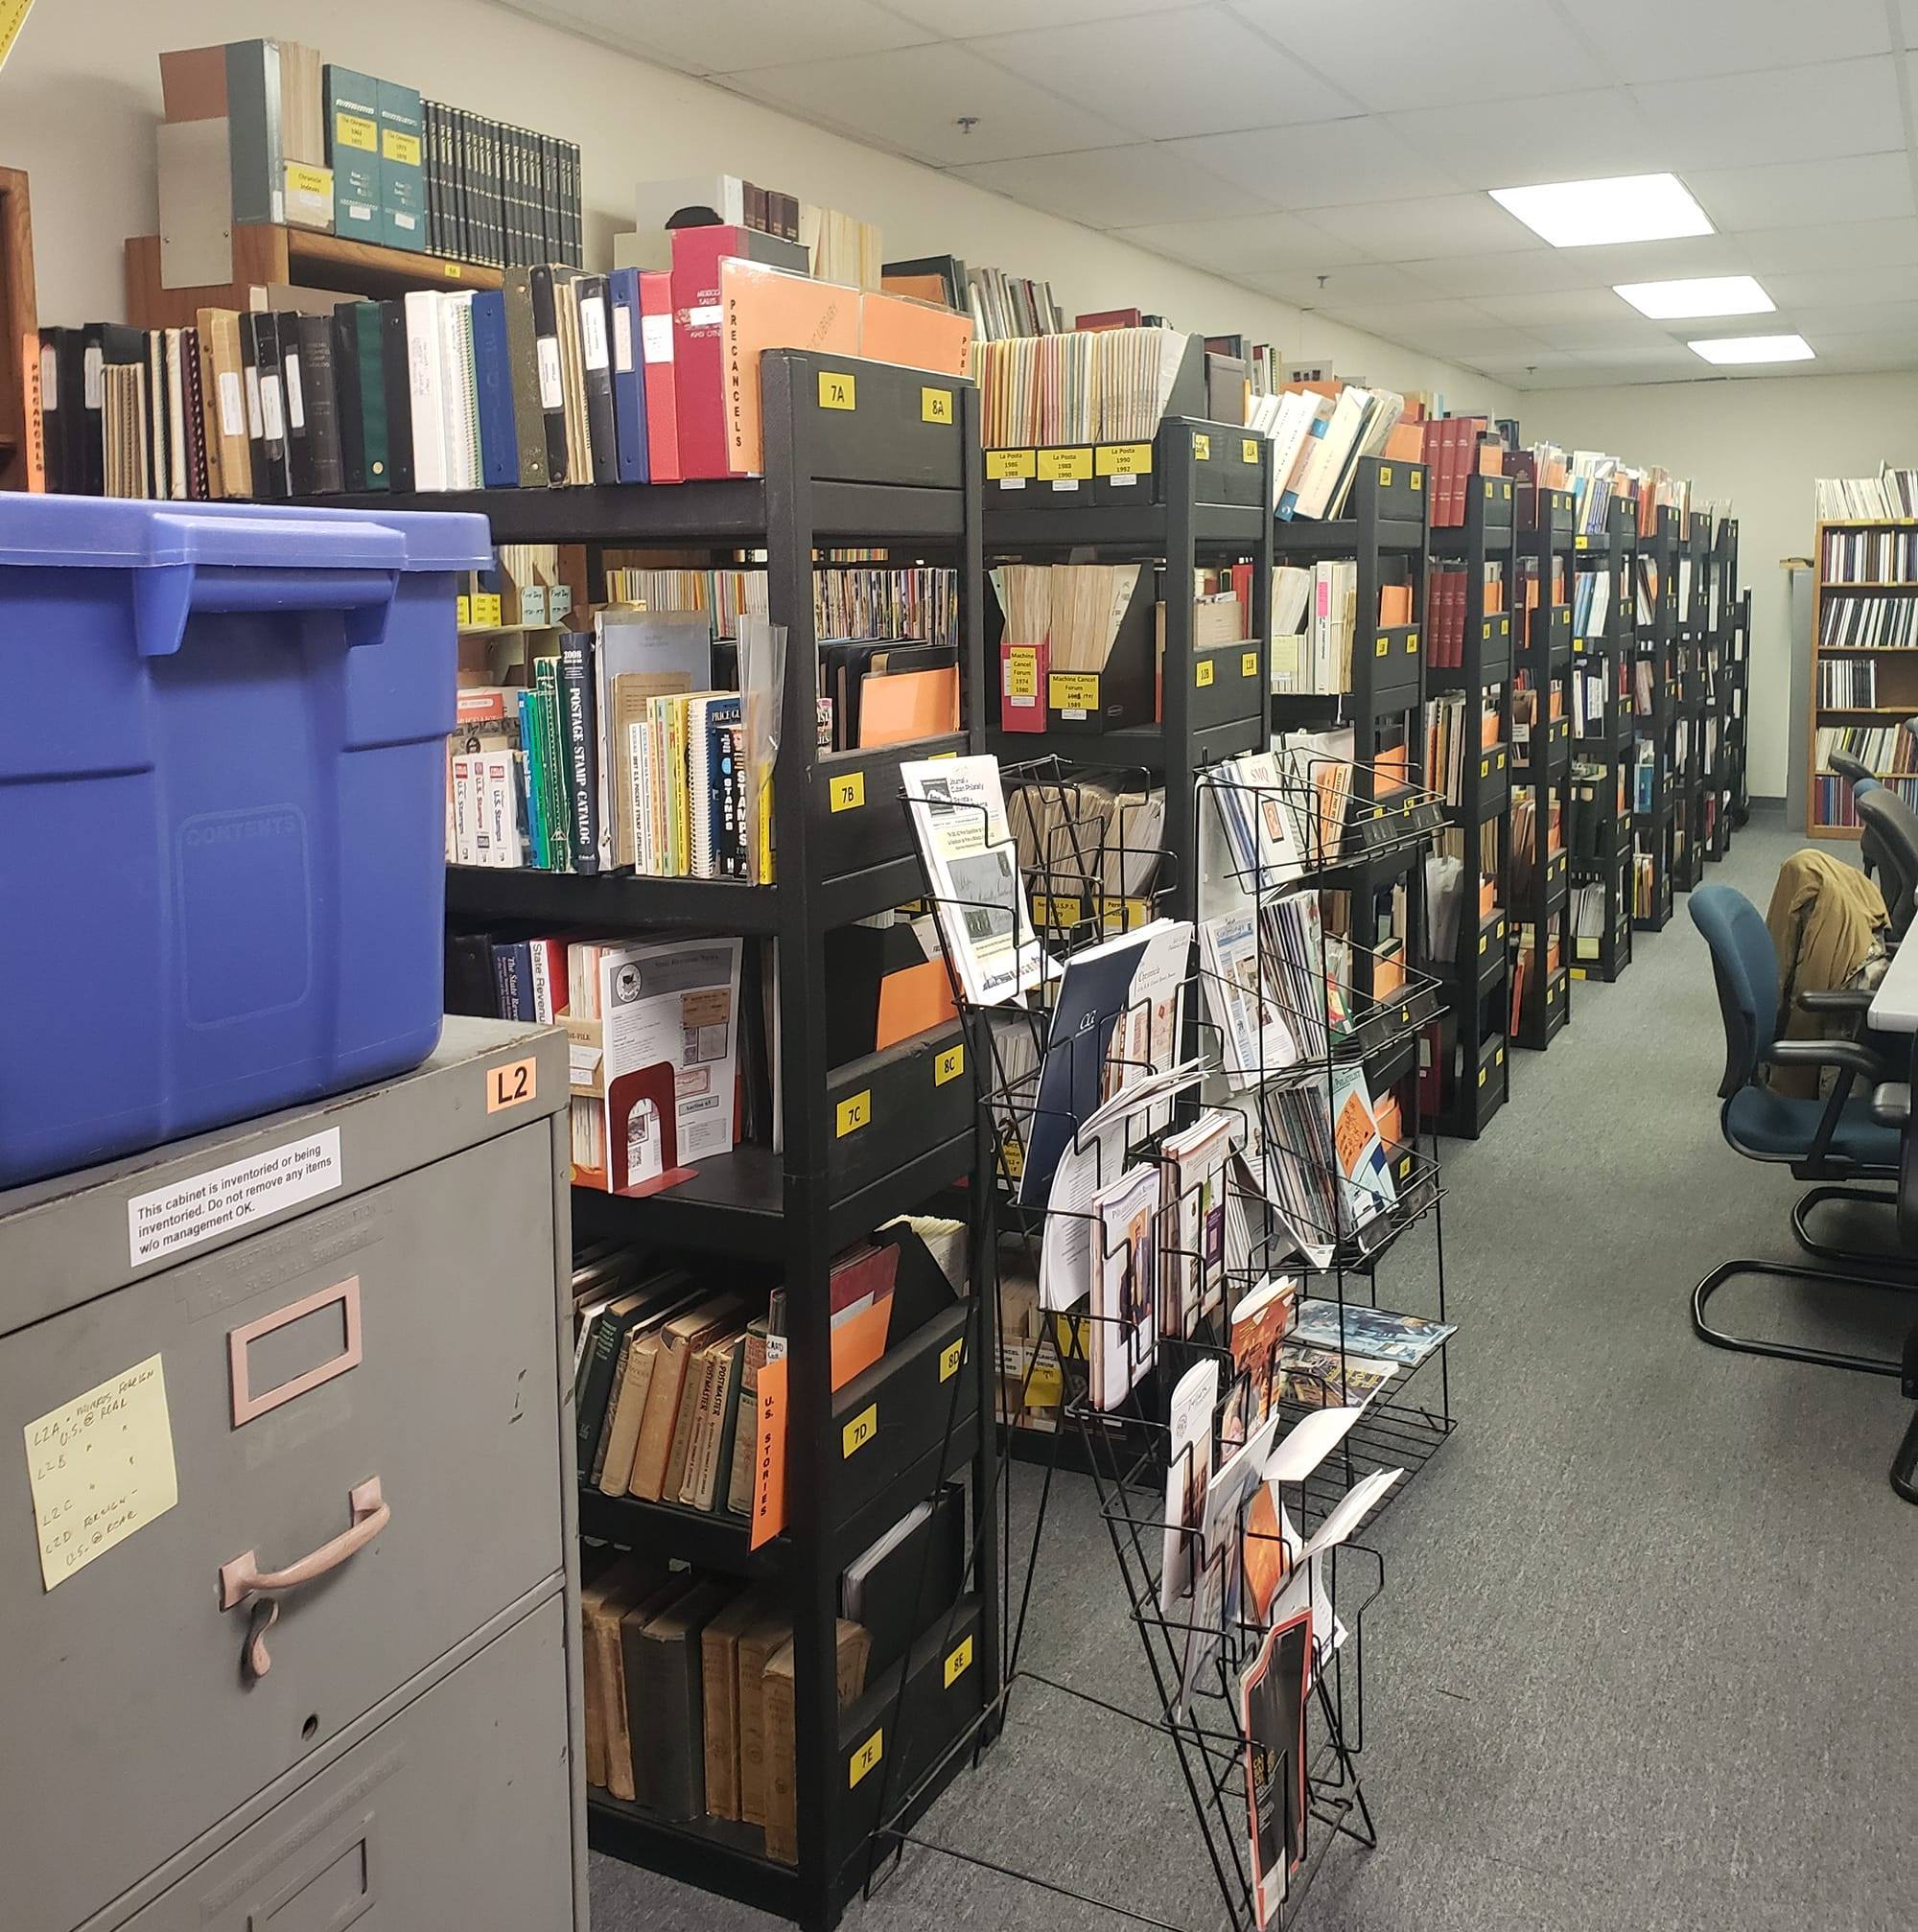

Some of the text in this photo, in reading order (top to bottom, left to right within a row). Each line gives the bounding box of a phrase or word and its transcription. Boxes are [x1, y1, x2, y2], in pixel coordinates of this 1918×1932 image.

[730, 299, 742, 448] PRECANCELS
[830, 384, 845, 403] 7A
[931, 399, 945, 416] 8A
[570, 687, 584, 742] POSTAGE
[712, 710, 730, 722] PRICE
[573, 746, 587, 786] STAMP
[724, 778, 734, 831] STAMPS
[737, 770, 747, 848] STAMPS
[841, 786, 854, 803] 7B
[577, 791, 591, 846] CATALOG
[509, 973, 519, 997] State
[532, 943, 547, 1025] State Revenu
[944, 1056, 955, 1073] 8C
[498, 1065, 528, 1105] L2
[848, 1105, 861, 1126] 7C
[138, 1145, 321, 1221] This cabinet is inventoried or being
[138, 1157, 332, 1238] inventoried. Do not remove any items
[139, 1201, 256, 1255] w/o management OK.
[947, 1349, 960, 1369] 8D
[700, 1360, 714, 1411] POSTMASTER
[712, 1365, 727, 1416] POSTMASTER
[854, 1421, 868, 1445] 7D
[760, 1432, 772, 1517] STORIES
[953, 1653, 965, 1672] 8E
[861, 1745, 874, 1769] 7E
